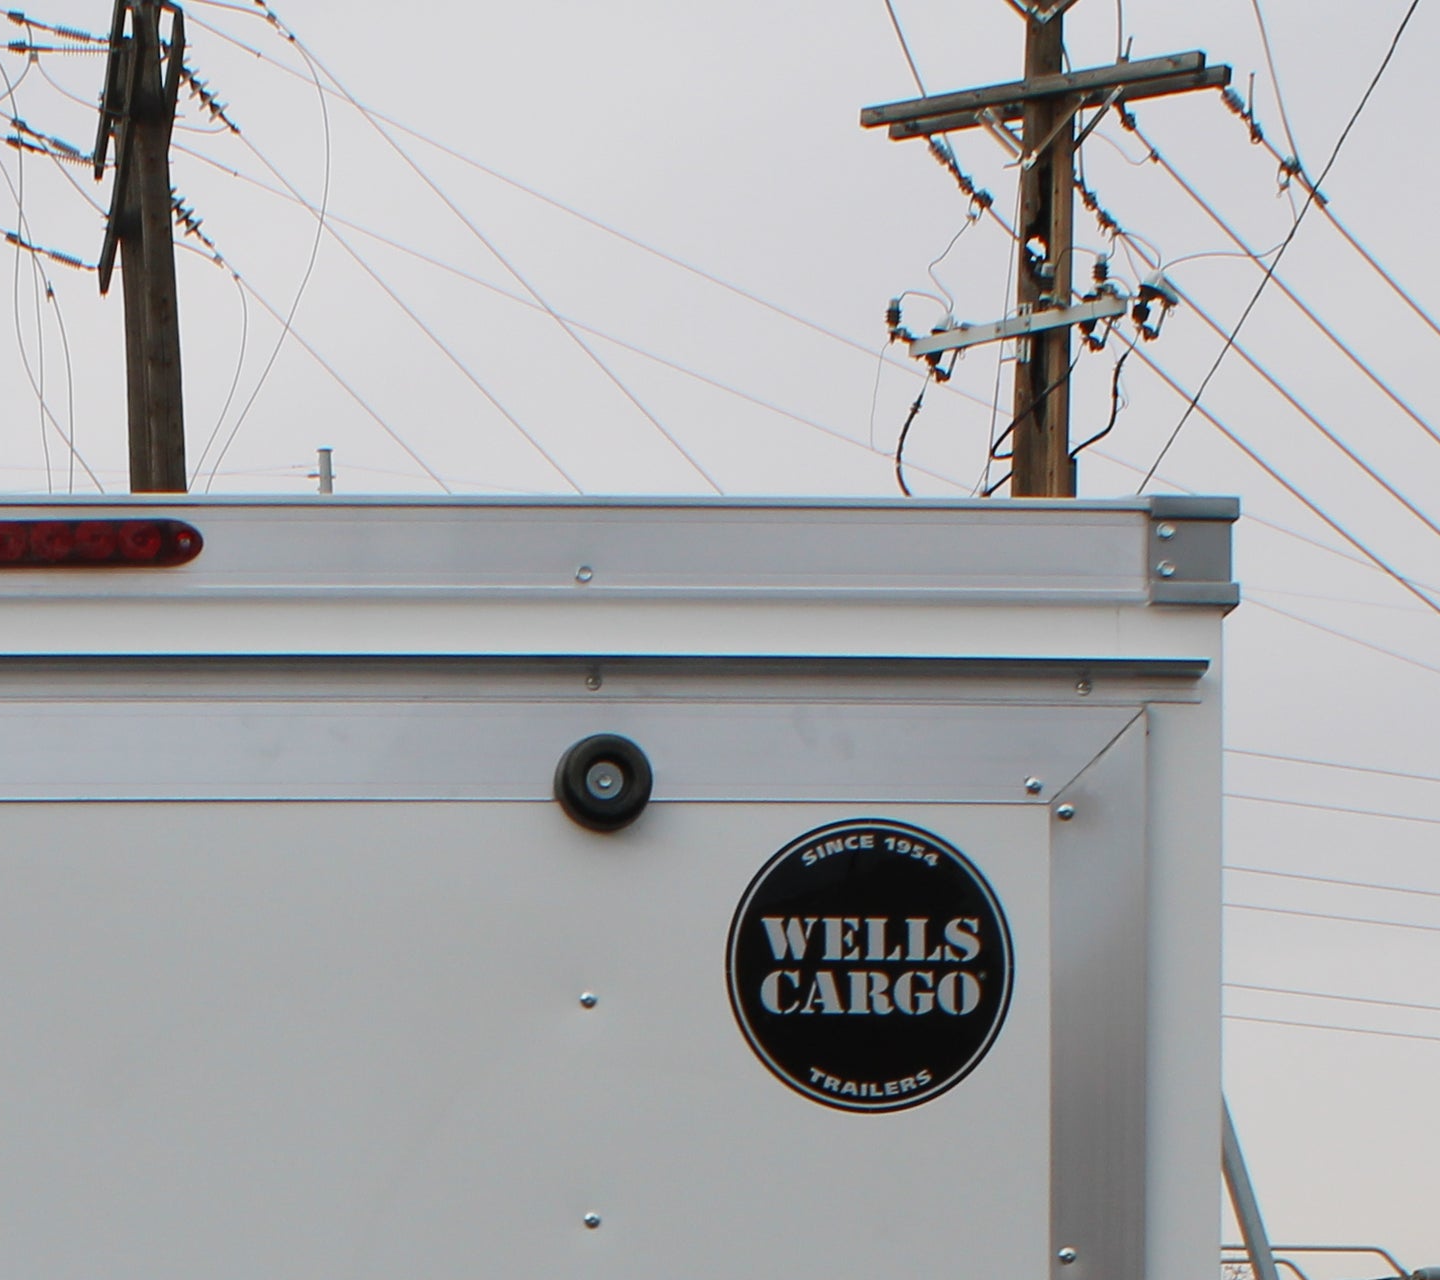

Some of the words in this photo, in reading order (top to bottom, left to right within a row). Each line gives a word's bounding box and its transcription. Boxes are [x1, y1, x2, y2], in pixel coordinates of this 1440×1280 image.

[801, 835, 874, 867] SINCE
[884, 837, 939, 867] 1954
[761, 917, 981, 962] WELLS
[760, 969, 981, 1016] CARGO
[809, 1066, 933, 1097] TRAILERS
